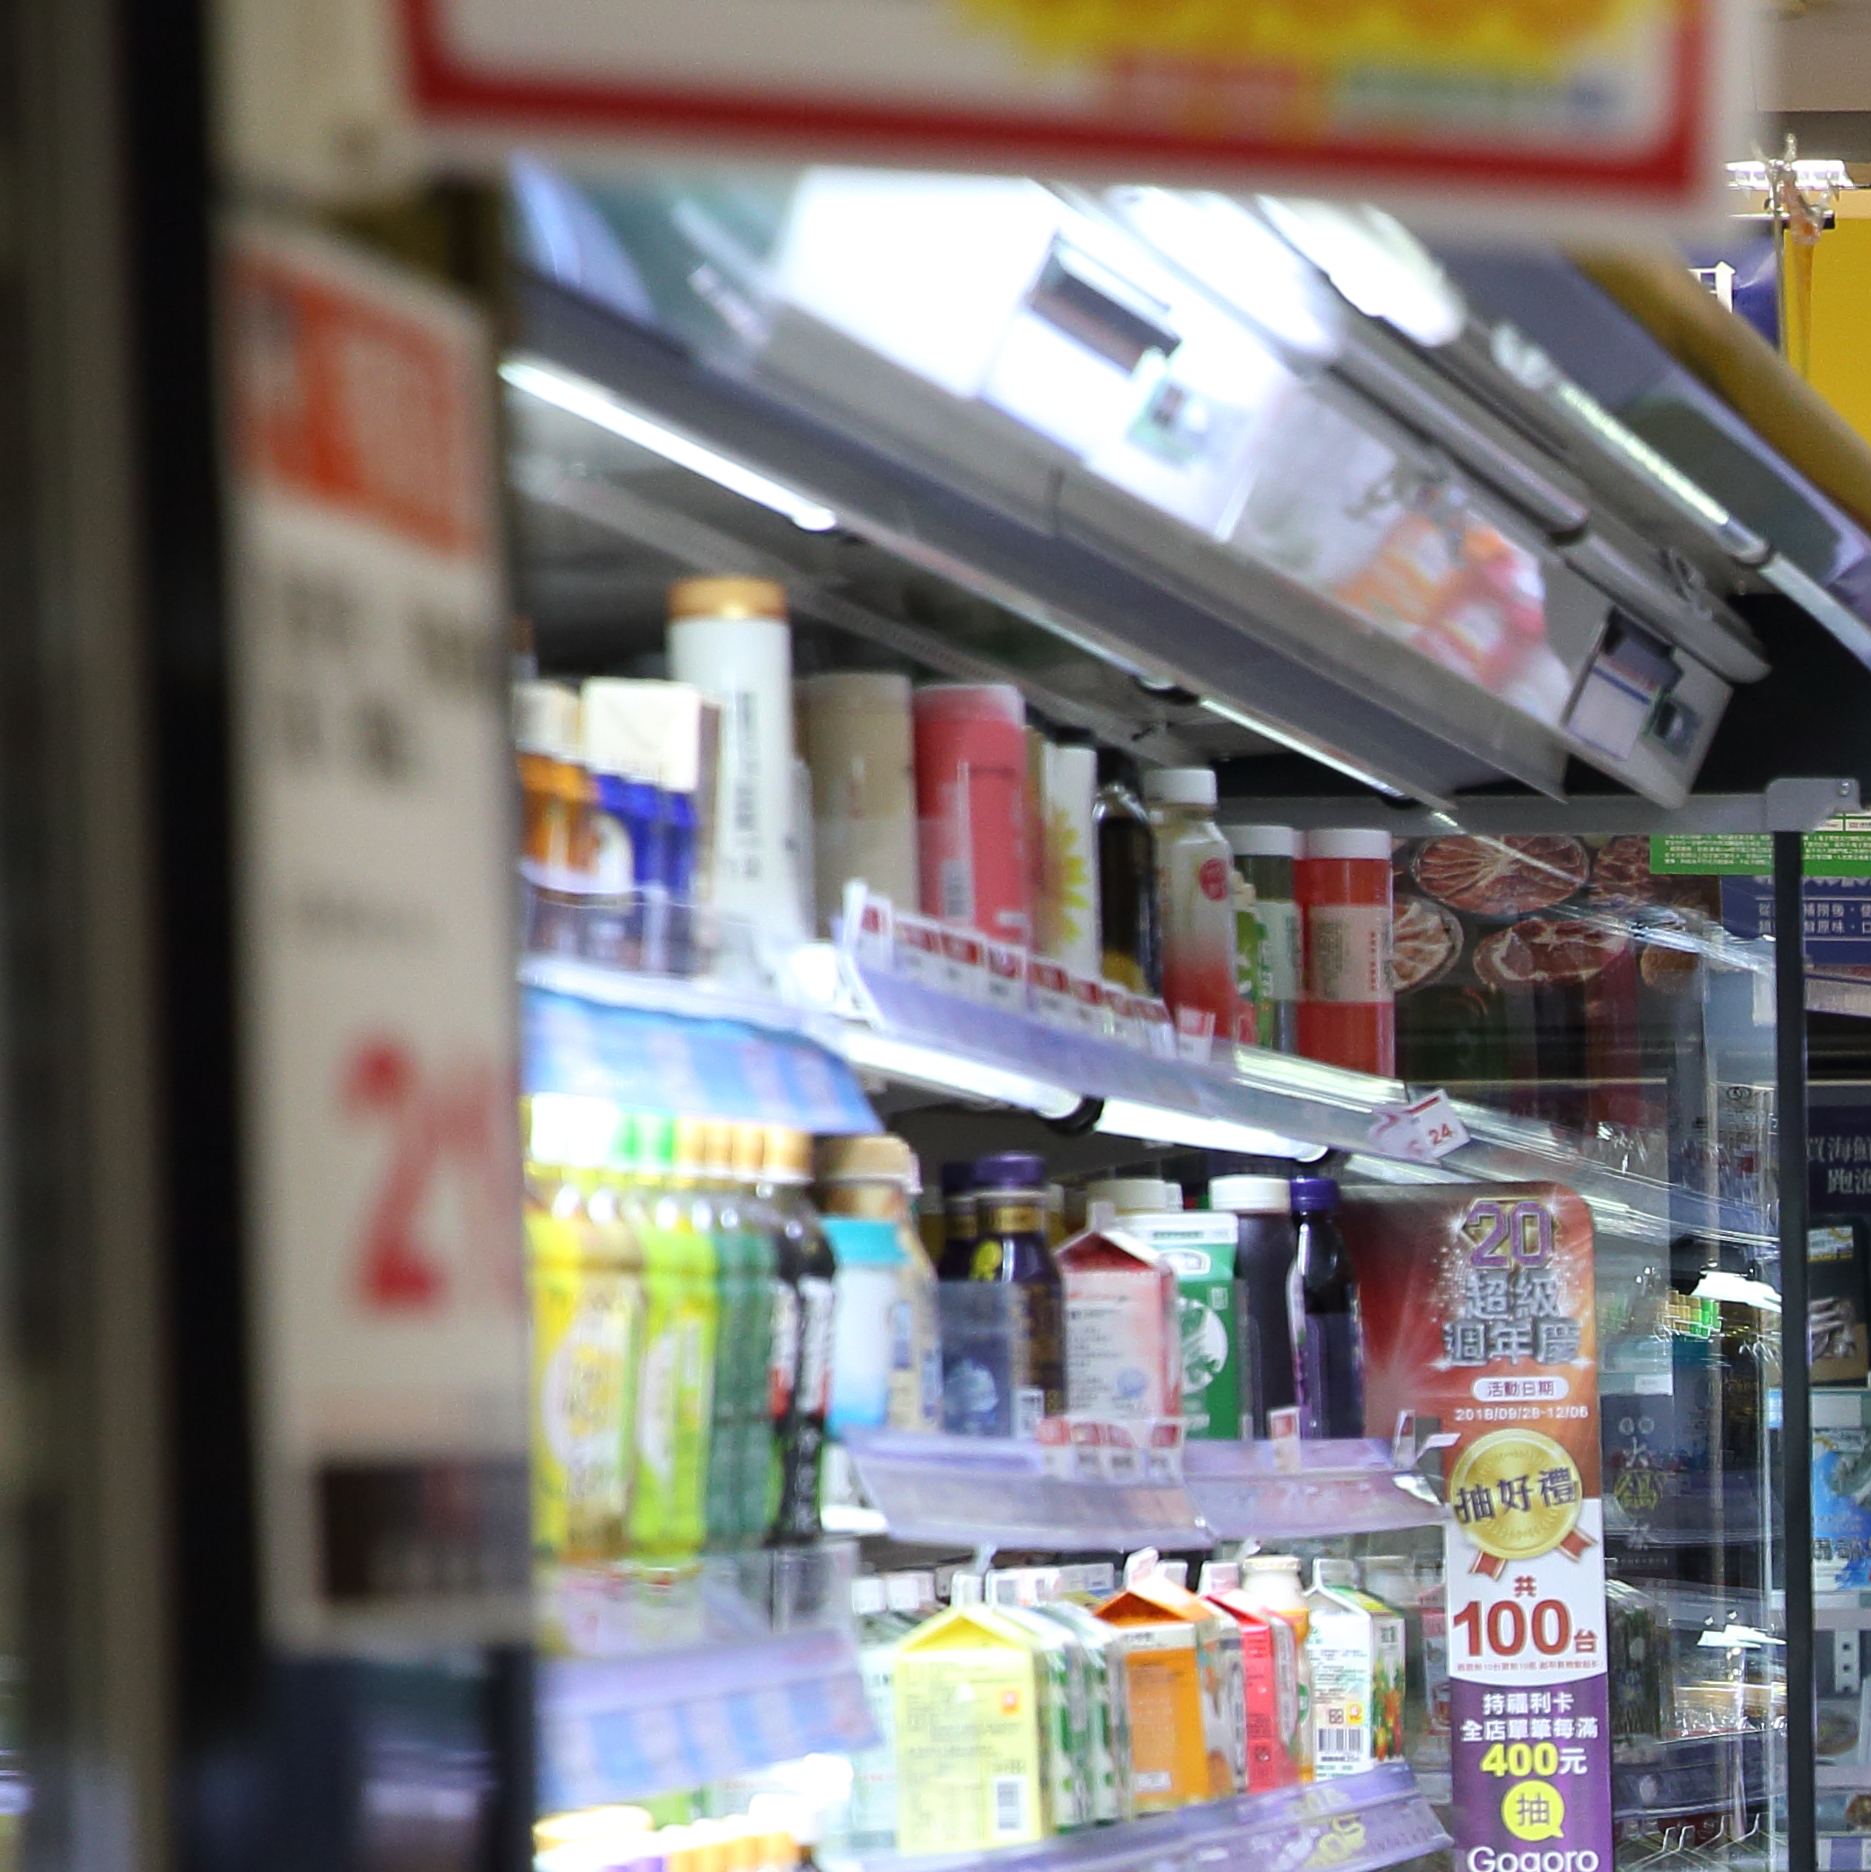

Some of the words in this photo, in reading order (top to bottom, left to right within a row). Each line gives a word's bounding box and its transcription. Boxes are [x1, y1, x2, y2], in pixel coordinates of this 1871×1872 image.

[1425, 1122, 1457, 1150] 24
[1467, 1201, 1555, 1269] 20
[1463, 1273, 1561, 1321] 超級
[1444, 1319, 1582, 1365] 週年慶
[1487, 1380, 1555, 1398] 活動日期
[1455, 1467, 1576, 1525] 抽好禮
[1514, 1576, 1537, 1598] 共
[1453, 1599, 1571, 1657] 100
[1574, 1630, 1598, 1654] 台
[1483, 1692, 1574, 1715] 持福利卡
[1461, 1718, 1598, 1742] 全店單筆每滿
[1480, 1742, 1588, 1778] 400元
[1517, 1792, 1551, 1826] 抽
